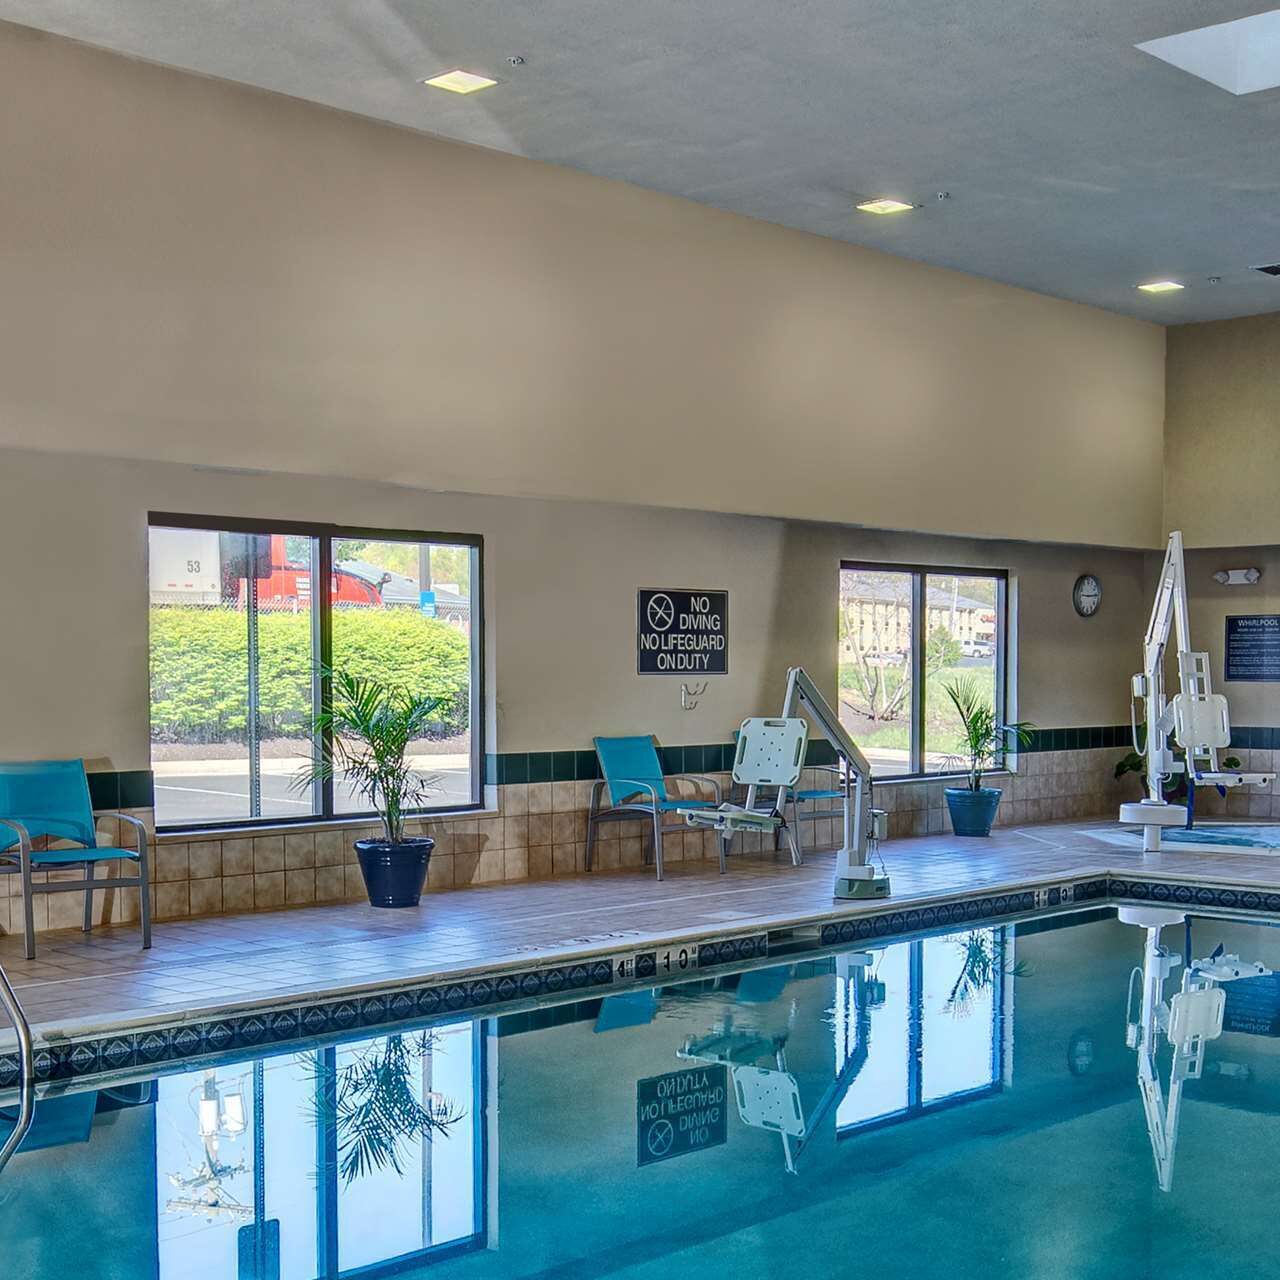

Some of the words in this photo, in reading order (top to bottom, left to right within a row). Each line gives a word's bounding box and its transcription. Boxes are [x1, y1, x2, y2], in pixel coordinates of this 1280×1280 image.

[186, 559, 201, 574] 53
[690, 596, 710, 613] NO
[679, 613, 721, 631] DIVING
[1237, 618, 1280, 627] WHIRLPOOL
[640, 633, 659, 650] NO
[661, 633, 725, 650] LIFEGUARD
[657, 652, 676, 670] ON
[677, 653, 710, 670] DUTY
